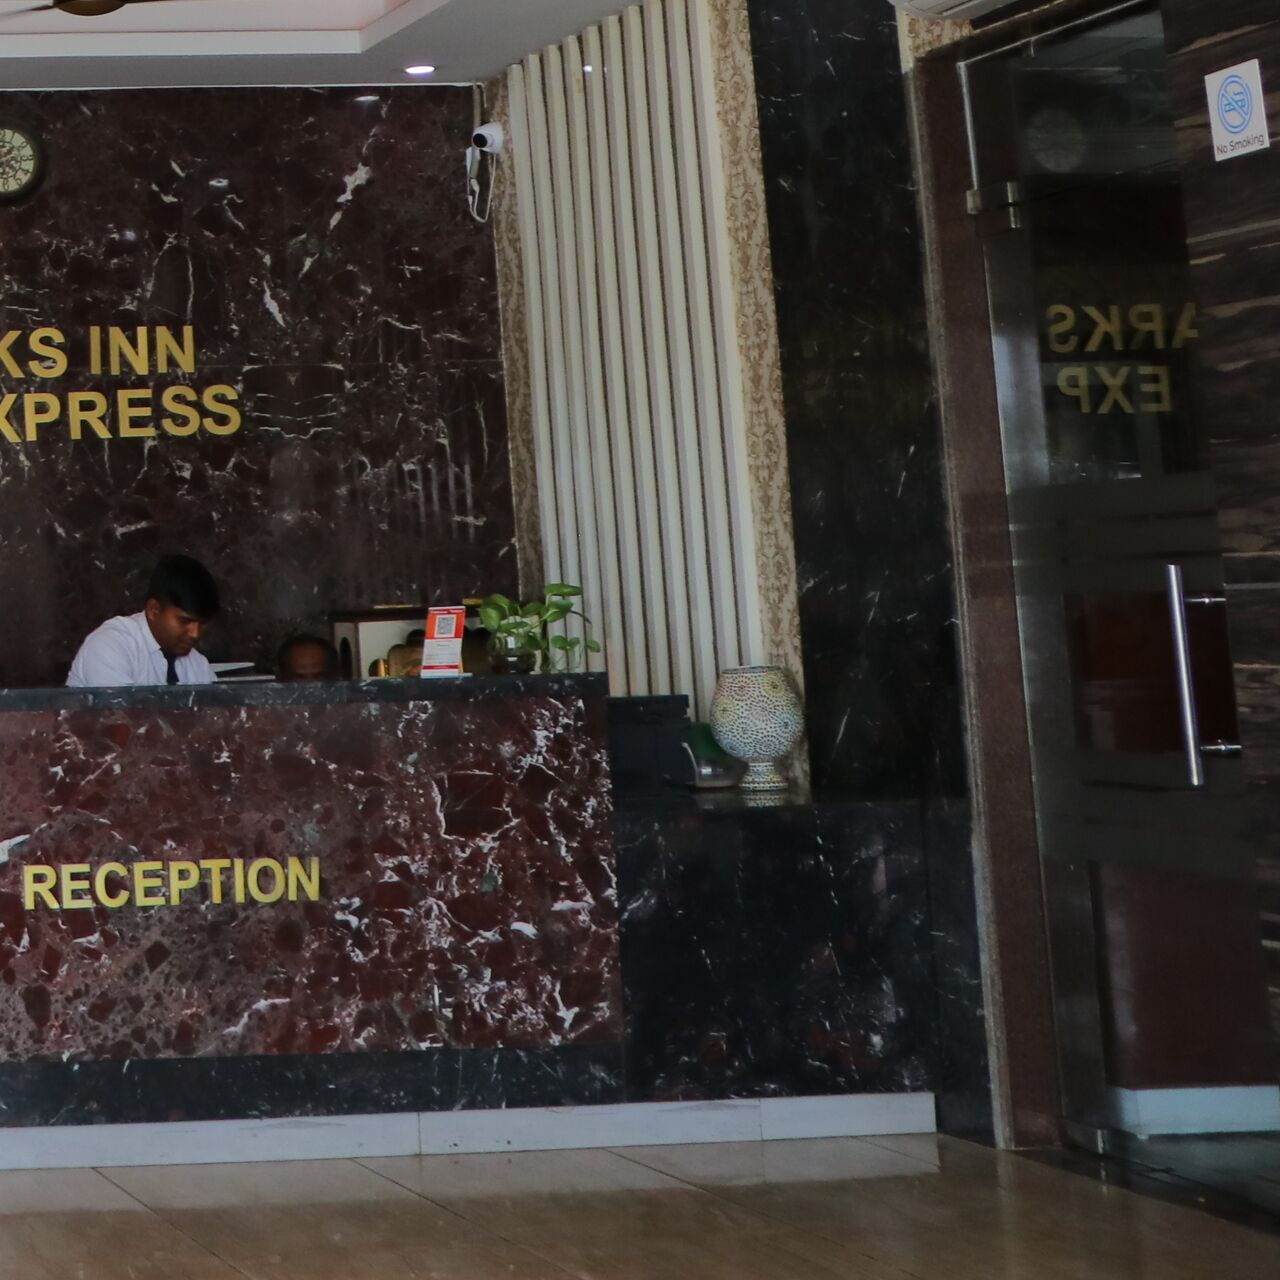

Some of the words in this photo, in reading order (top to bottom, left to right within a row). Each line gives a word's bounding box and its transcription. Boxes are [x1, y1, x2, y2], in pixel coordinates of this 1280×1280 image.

[1216, 144, 1228, 155] No
[1229, 134, 1265, 152] Smoking
[89, 324, 196, 376] INN
[23, 856, 320, 911] RECEPTION
